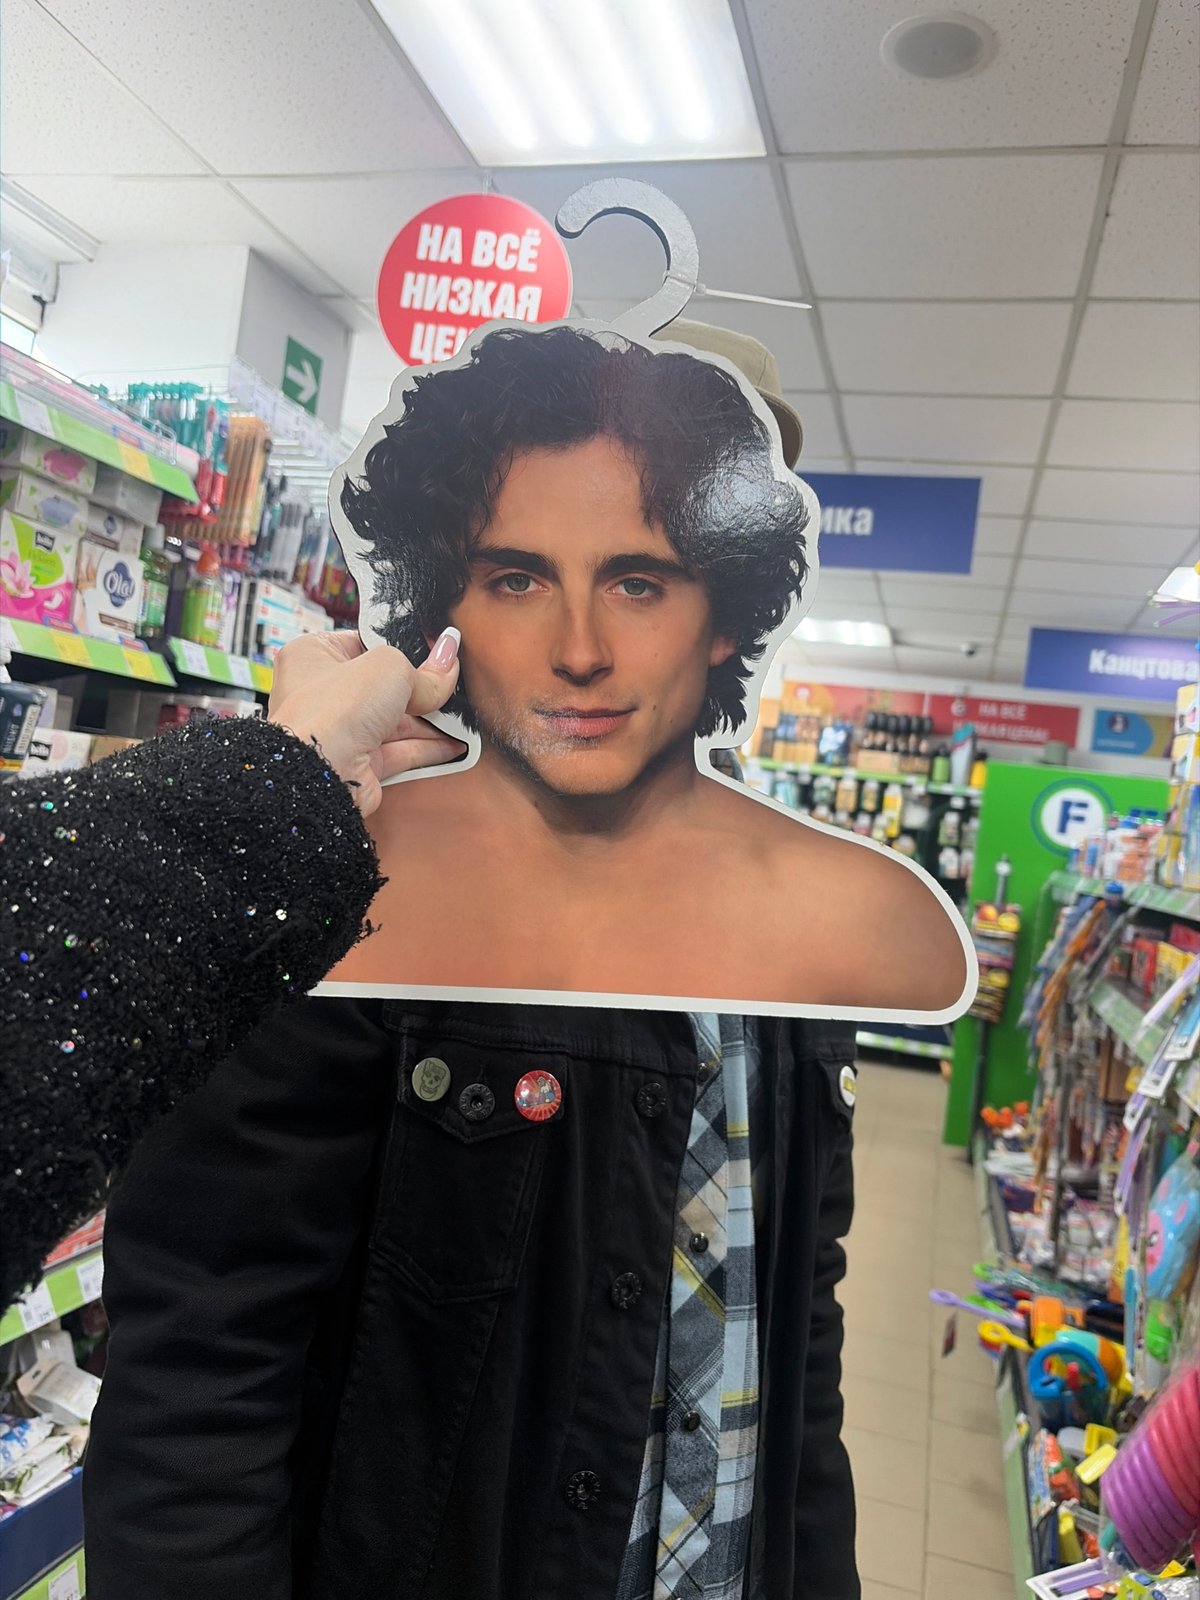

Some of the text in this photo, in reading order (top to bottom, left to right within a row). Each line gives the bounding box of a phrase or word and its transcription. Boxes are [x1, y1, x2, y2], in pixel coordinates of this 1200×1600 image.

[416, 223, 541, 273] НА ВСЁ
[400, 272, 541, 322] НИЗКАЯ
[105, 570, 134, 599] Ola!
[1057, 799, 1089, 834] F
